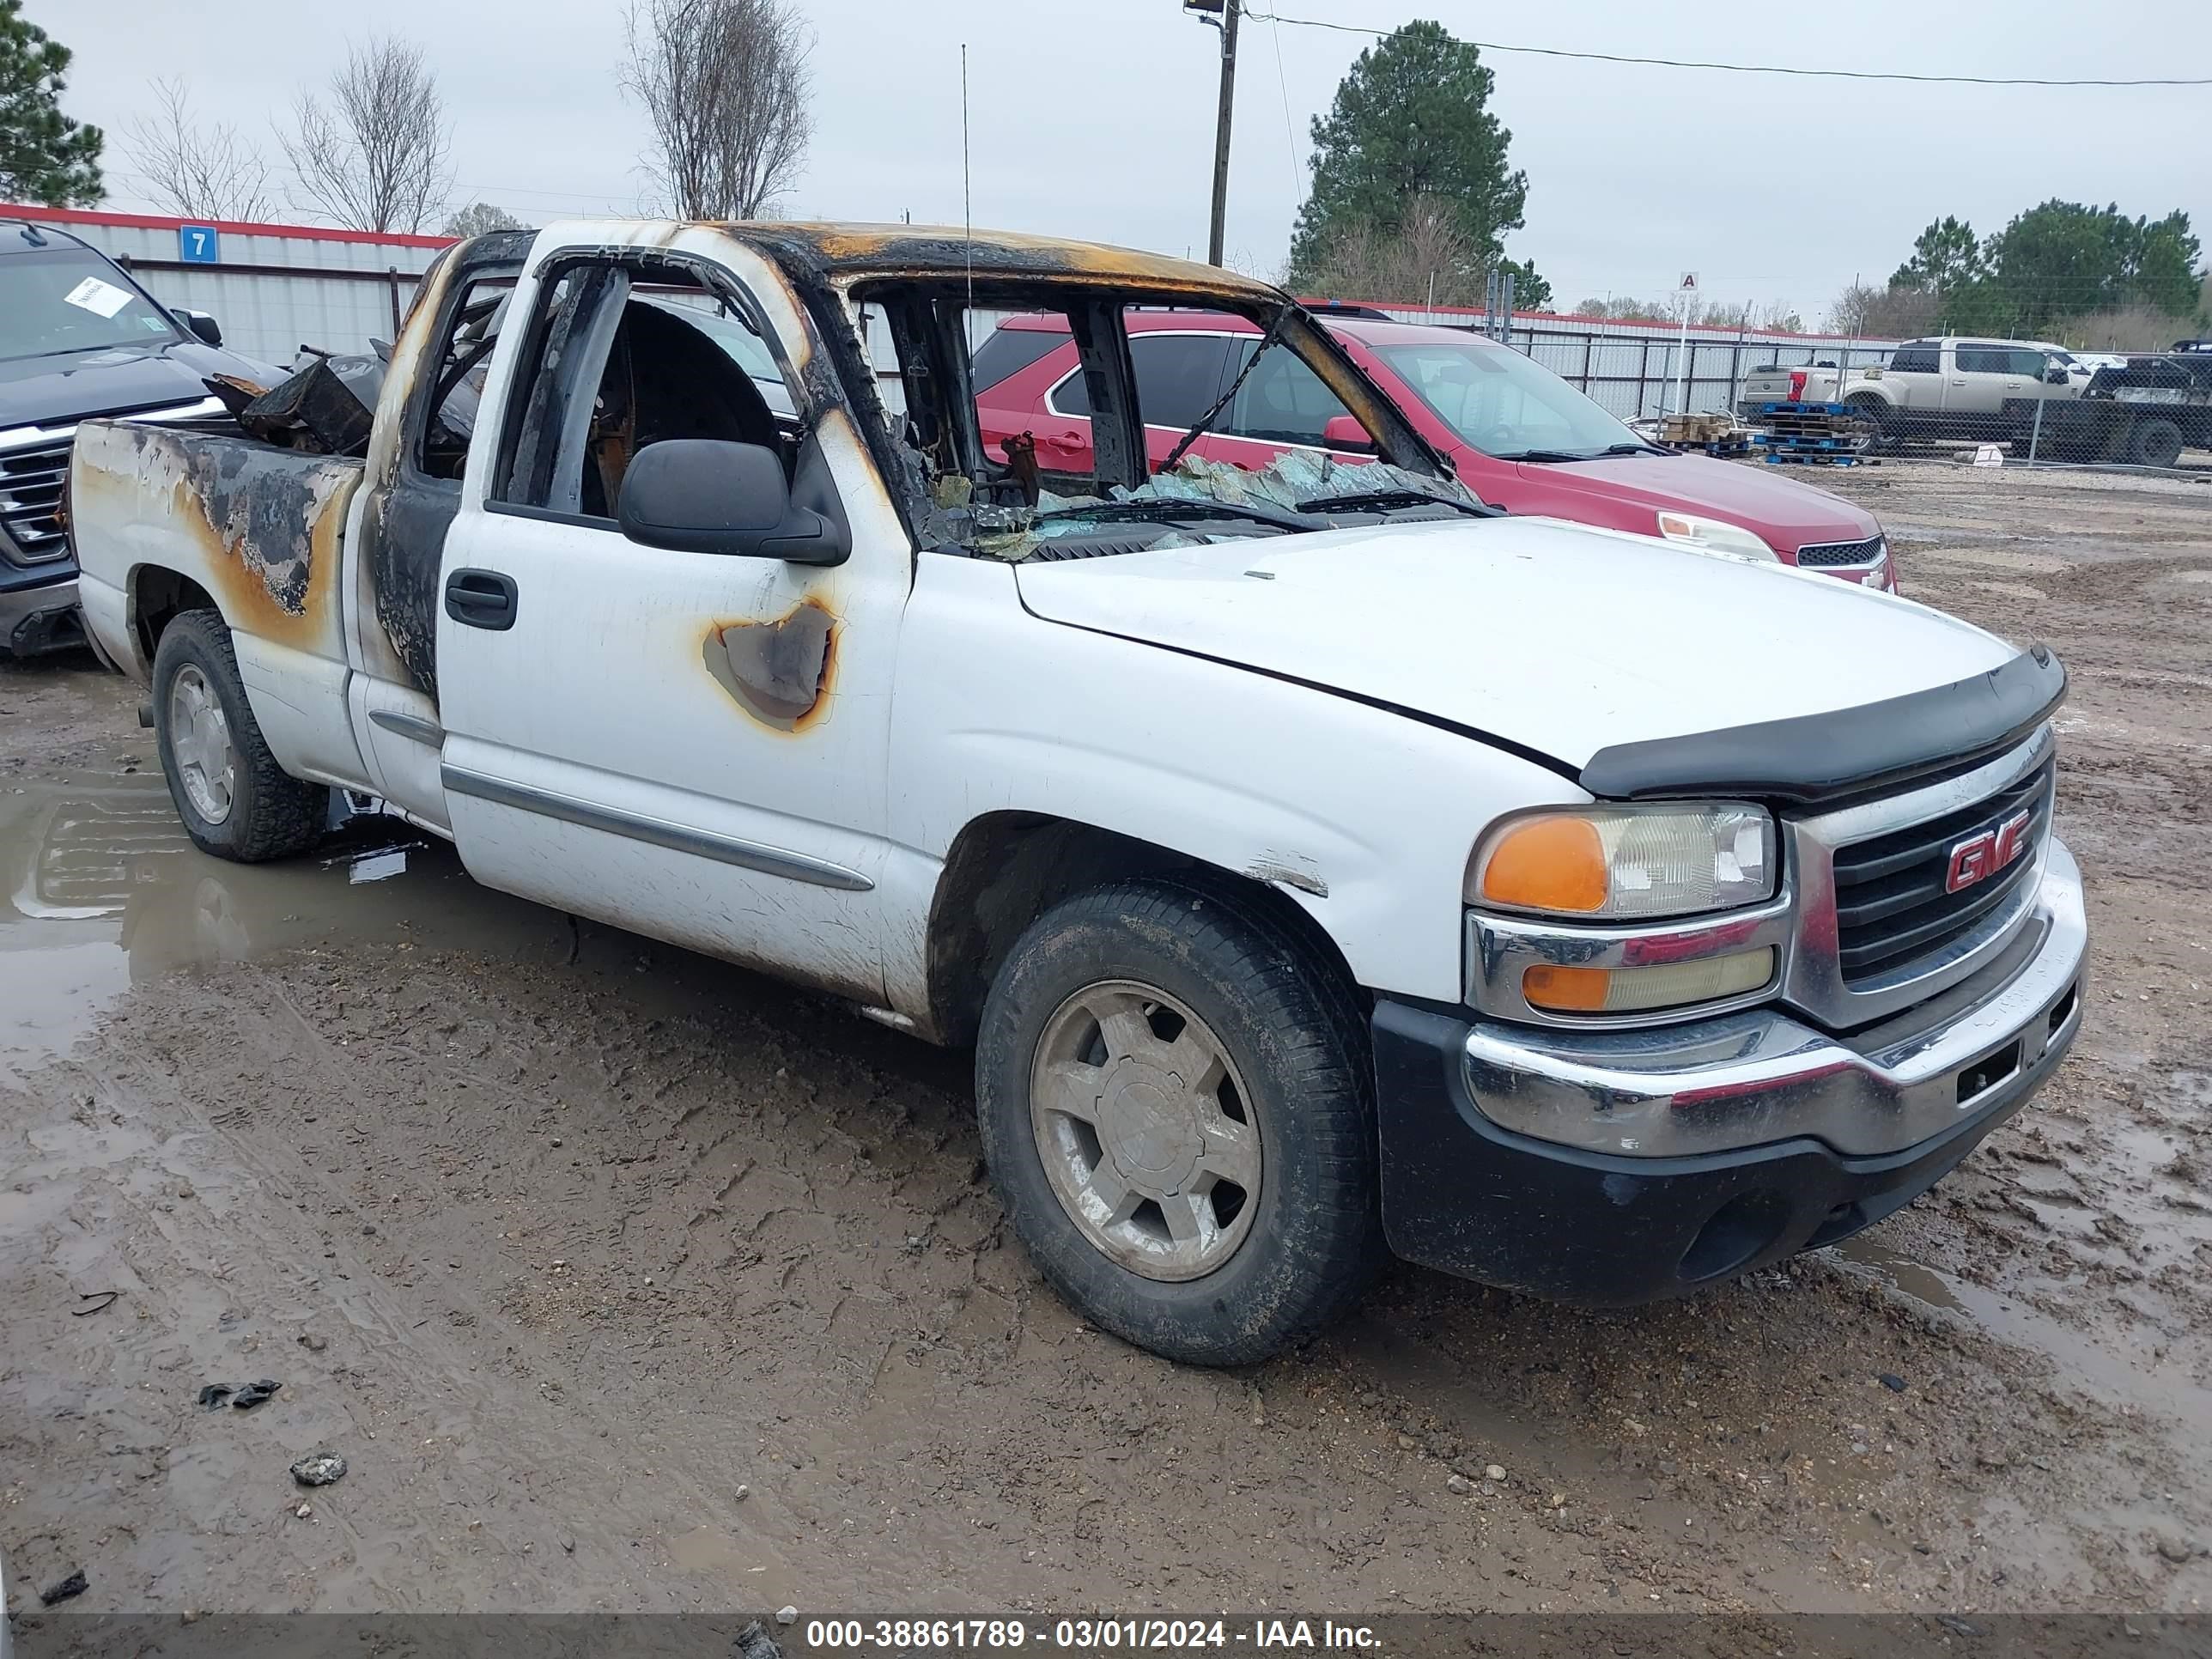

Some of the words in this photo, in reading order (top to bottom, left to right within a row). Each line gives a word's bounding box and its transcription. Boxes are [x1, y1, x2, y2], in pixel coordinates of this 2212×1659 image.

[192, 233, 206, 255] 7
[1683, 274, 1694, 287] A
[1945, 808, 2029, 894] GMC
